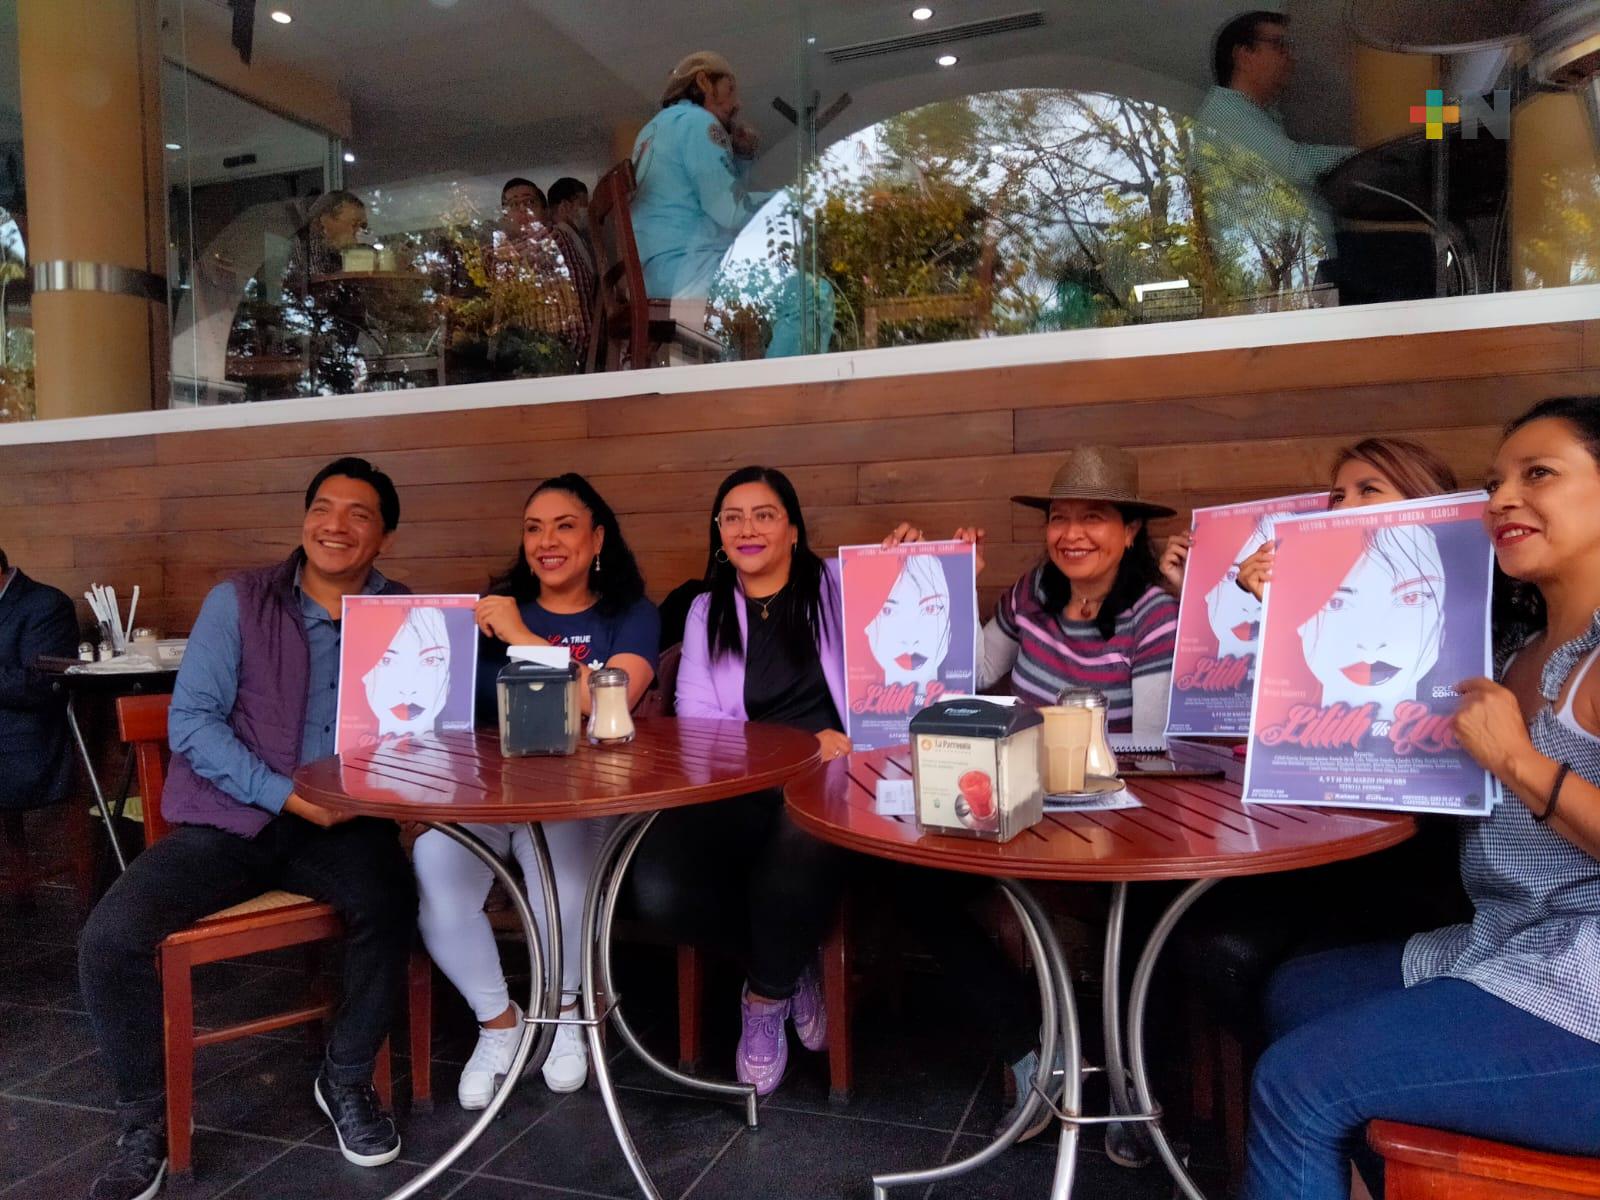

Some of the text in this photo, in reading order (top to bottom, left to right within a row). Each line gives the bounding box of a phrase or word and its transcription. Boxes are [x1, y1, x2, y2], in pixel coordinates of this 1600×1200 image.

[1399, 511, 1425, 522] LORENA
[570, 635, 592, 644] TRUE
[850, 682, 916, 715] Lilith
[1260, 702, 1376, 749] Lilith
